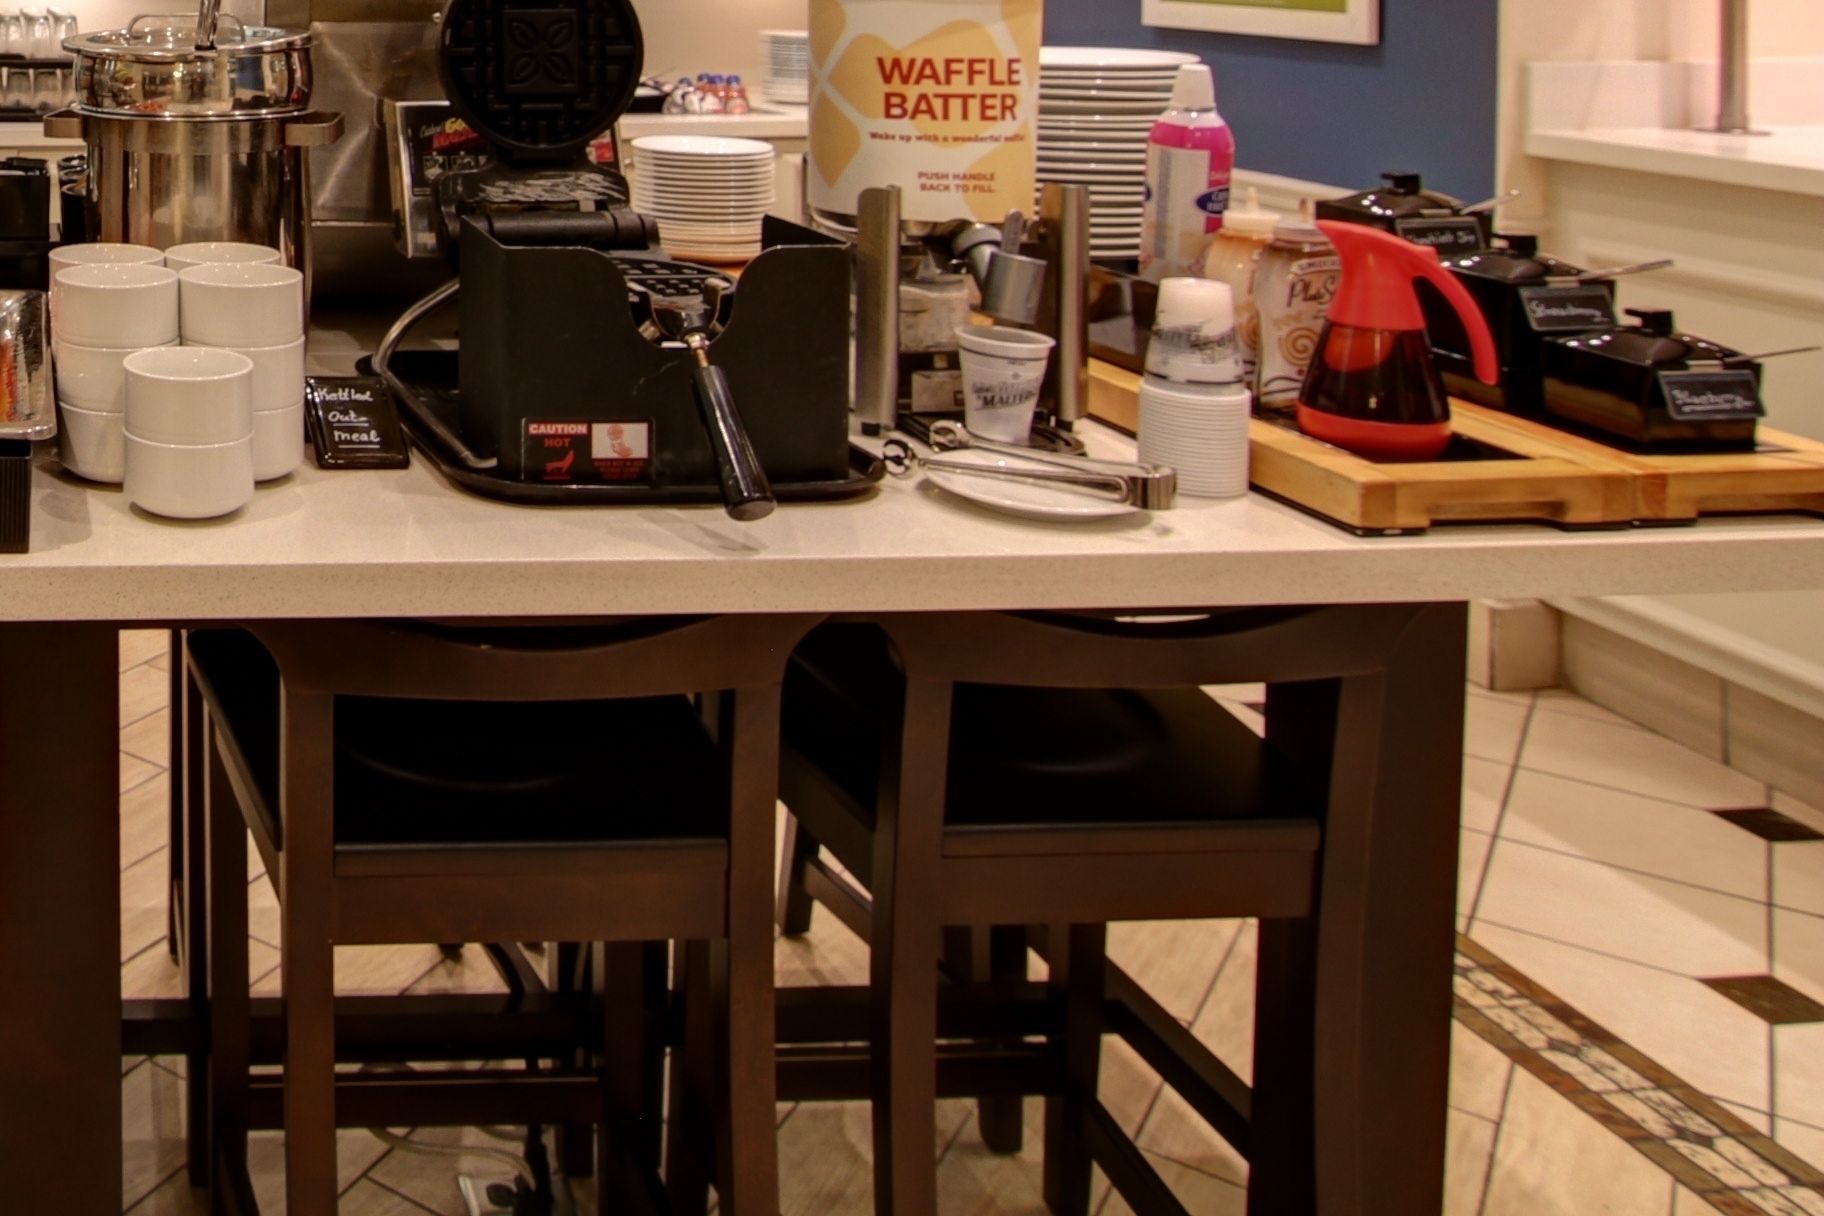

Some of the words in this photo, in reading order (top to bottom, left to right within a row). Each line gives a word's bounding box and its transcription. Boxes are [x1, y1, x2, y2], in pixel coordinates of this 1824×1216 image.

[877, 57, 1022, 86] WAFFLE
[883, 92, 1018, 121] BATTER
[899, 133, 912, 143] up
[915, 132, 939, 142] with
[951, 133, 1001, 142] wonderful
[918, 171, 949, 181] PUSH
[953, 171, 995, 181] HANDLE
[920, 183, 950, 193] BACK
[955, 183, 970, 193] TO
[528, 423, 588, 435] CAUTION
[544, 437, 571, 448] HOT
